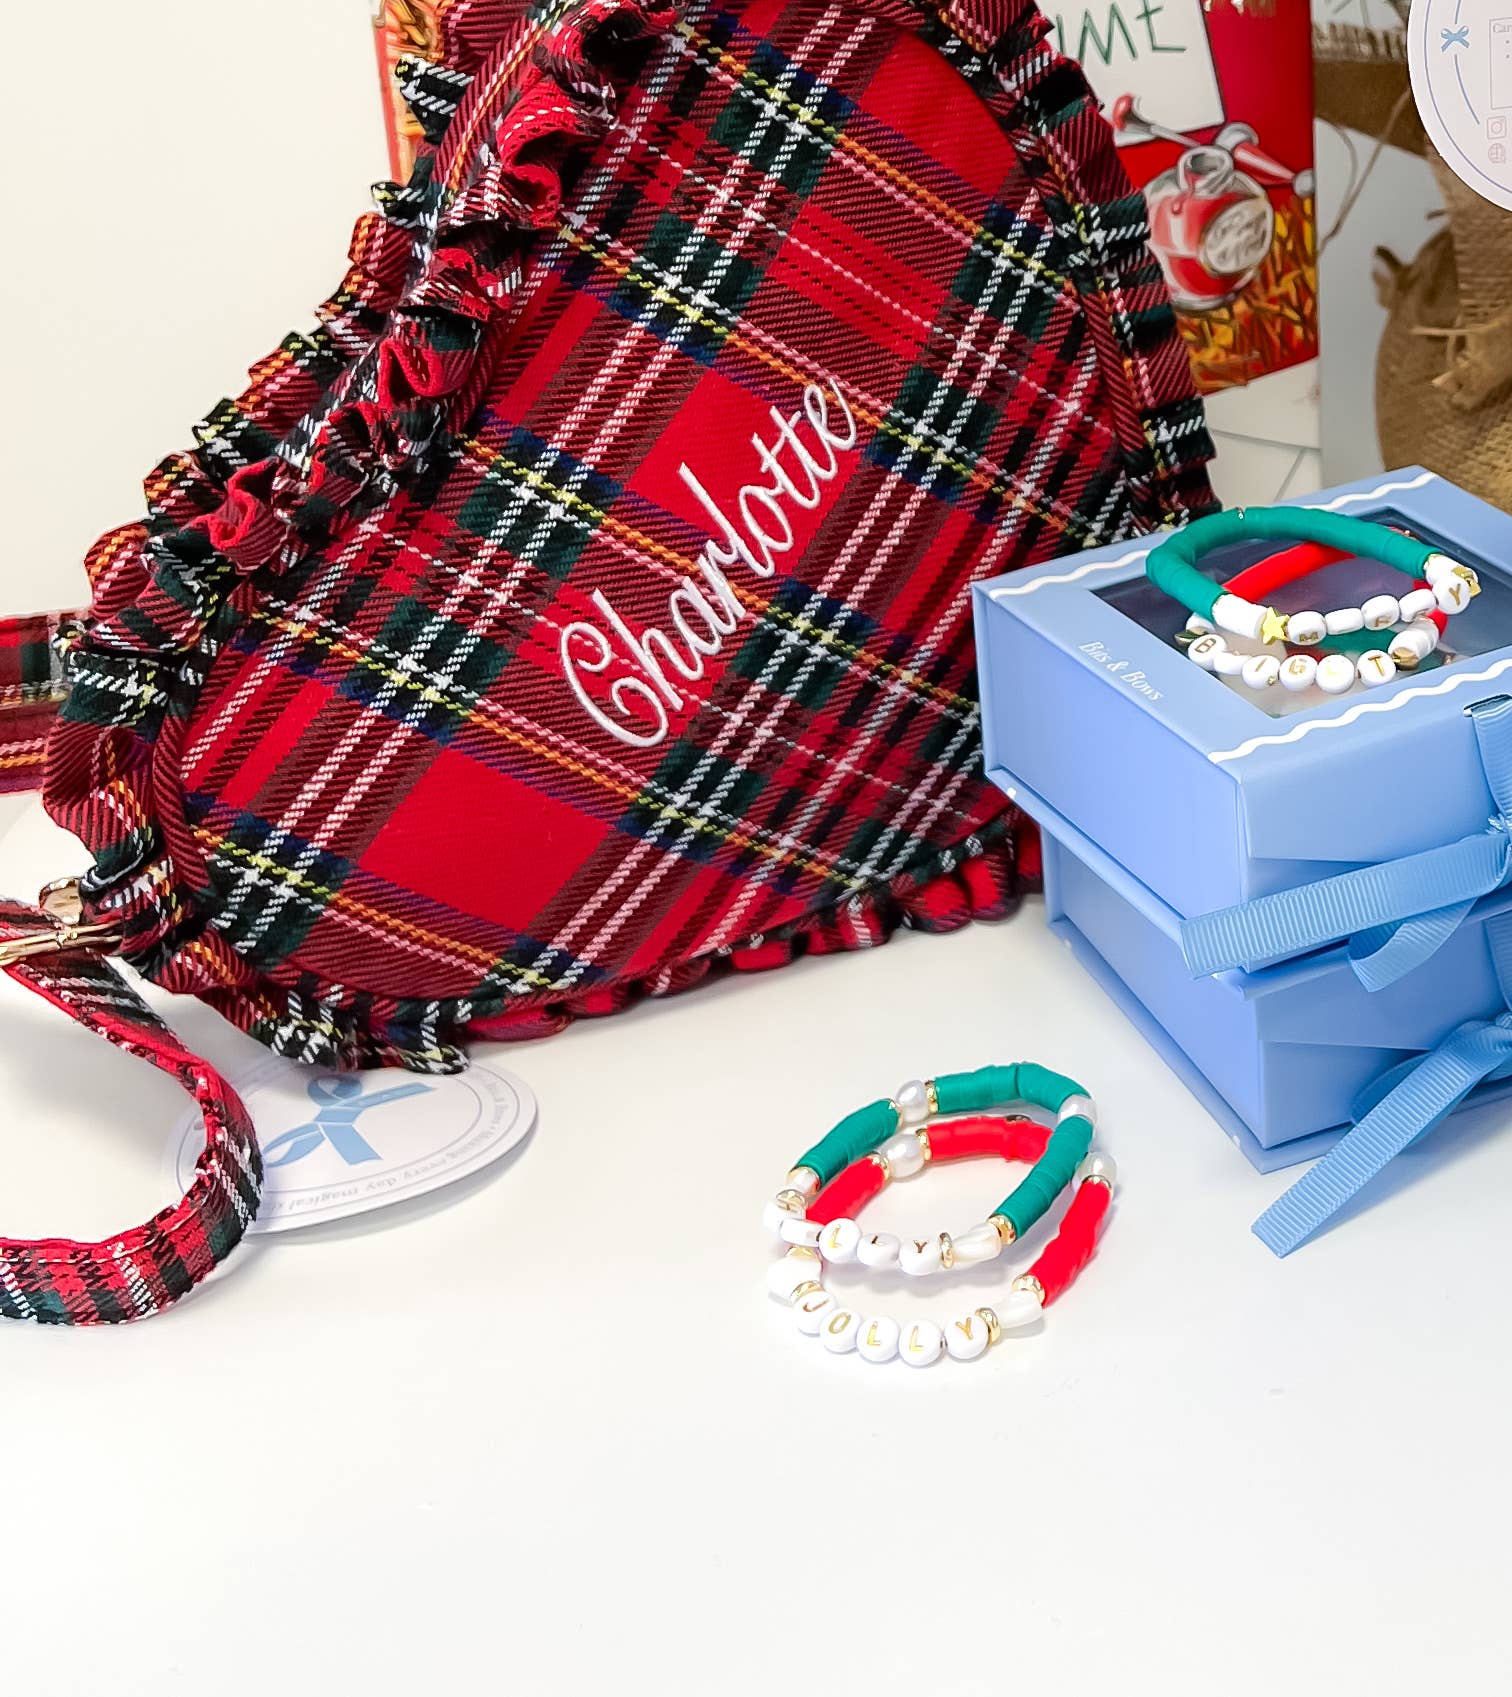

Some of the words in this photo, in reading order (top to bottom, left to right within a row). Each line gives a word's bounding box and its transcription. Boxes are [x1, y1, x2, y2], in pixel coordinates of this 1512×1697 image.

[560, 377, 857, 747] Charlotte
[1078, 641, 1112, 663] Bits
[1106, 661, 1129, 673] &
[1120, 671, 1164, 701] Bows
[366, 1176, 398, 1192] day
[801, 1297, 973, 1352] JOLLY
